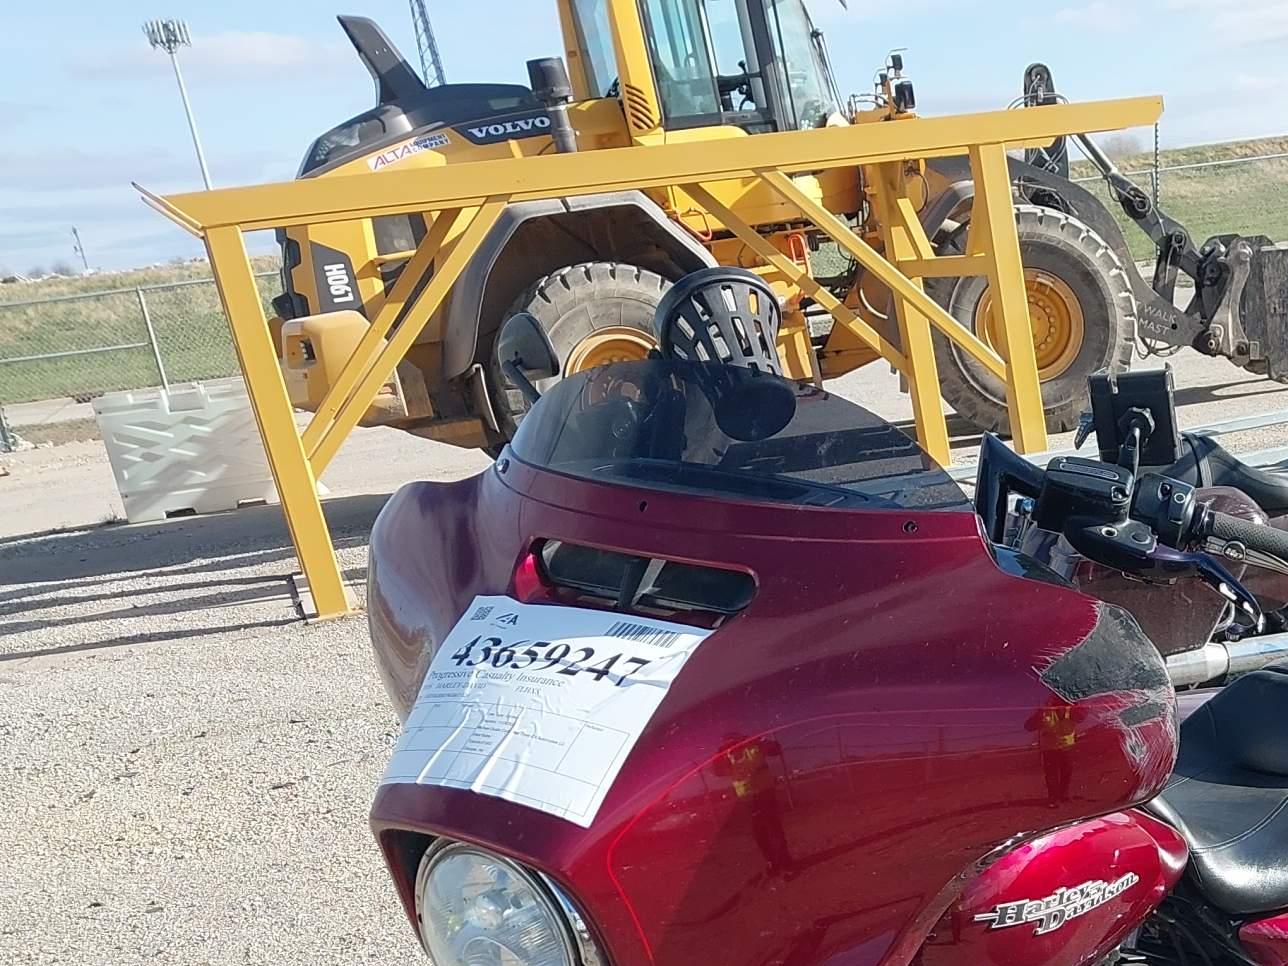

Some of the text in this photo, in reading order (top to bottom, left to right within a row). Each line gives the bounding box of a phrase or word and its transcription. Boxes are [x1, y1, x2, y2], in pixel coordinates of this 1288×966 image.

[468, 116, 551, 139] VOLVO
[374, 144, 413, 170] ALTA
[412, 138, 449, 153] COMPANY
[323, 263, 354, 303] L90H
[1144, 303, 1177, 324] WALK
[1139, 317, 1170, 335] MAST
[451, 634, 651, 687] 43659247
[475, 669, 515, 682] Casualty
[516, 671, 566, 688] Insurance
[1036, 872, 1140, 935] Davidson
